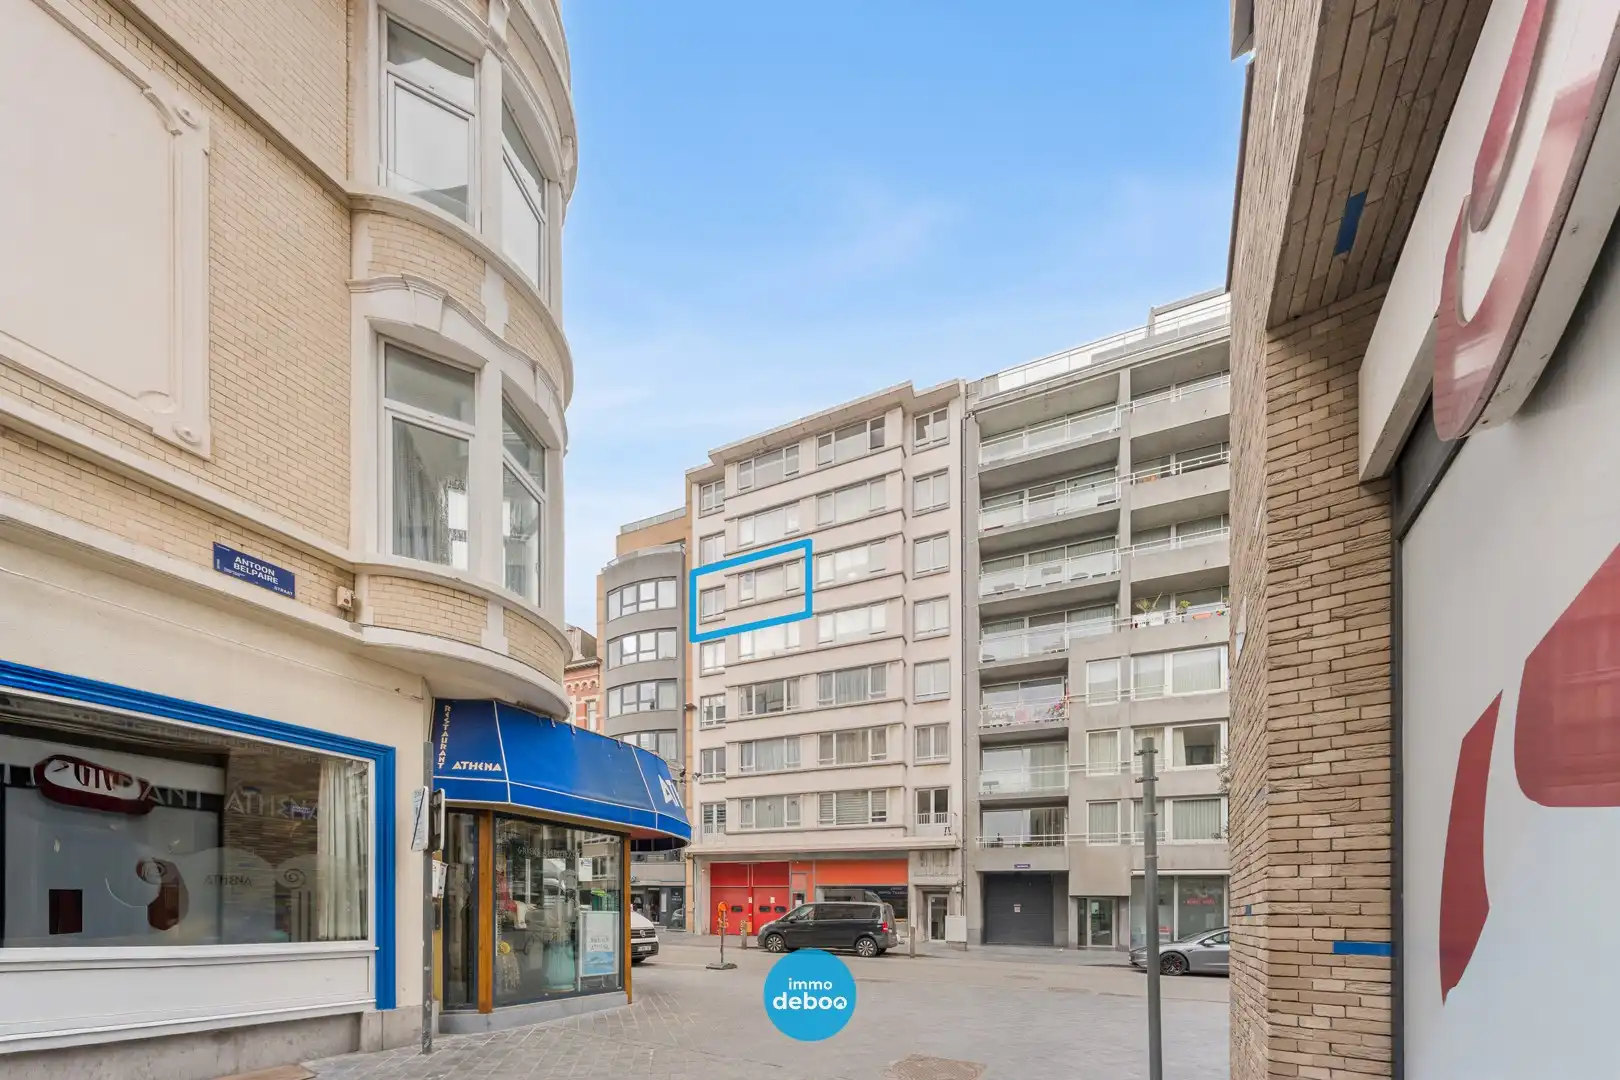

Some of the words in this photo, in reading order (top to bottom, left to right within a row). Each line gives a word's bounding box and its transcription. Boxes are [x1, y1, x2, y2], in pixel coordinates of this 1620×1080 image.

[233, 562, 279, 585] BELPAIRE
[235, 556, 275, 577] ANTOON
[273, 585, 293, 596] STRAAT
[437, 704, 452, 769] RESTAURANT
[452, 760, 502, 771] ATHENA
